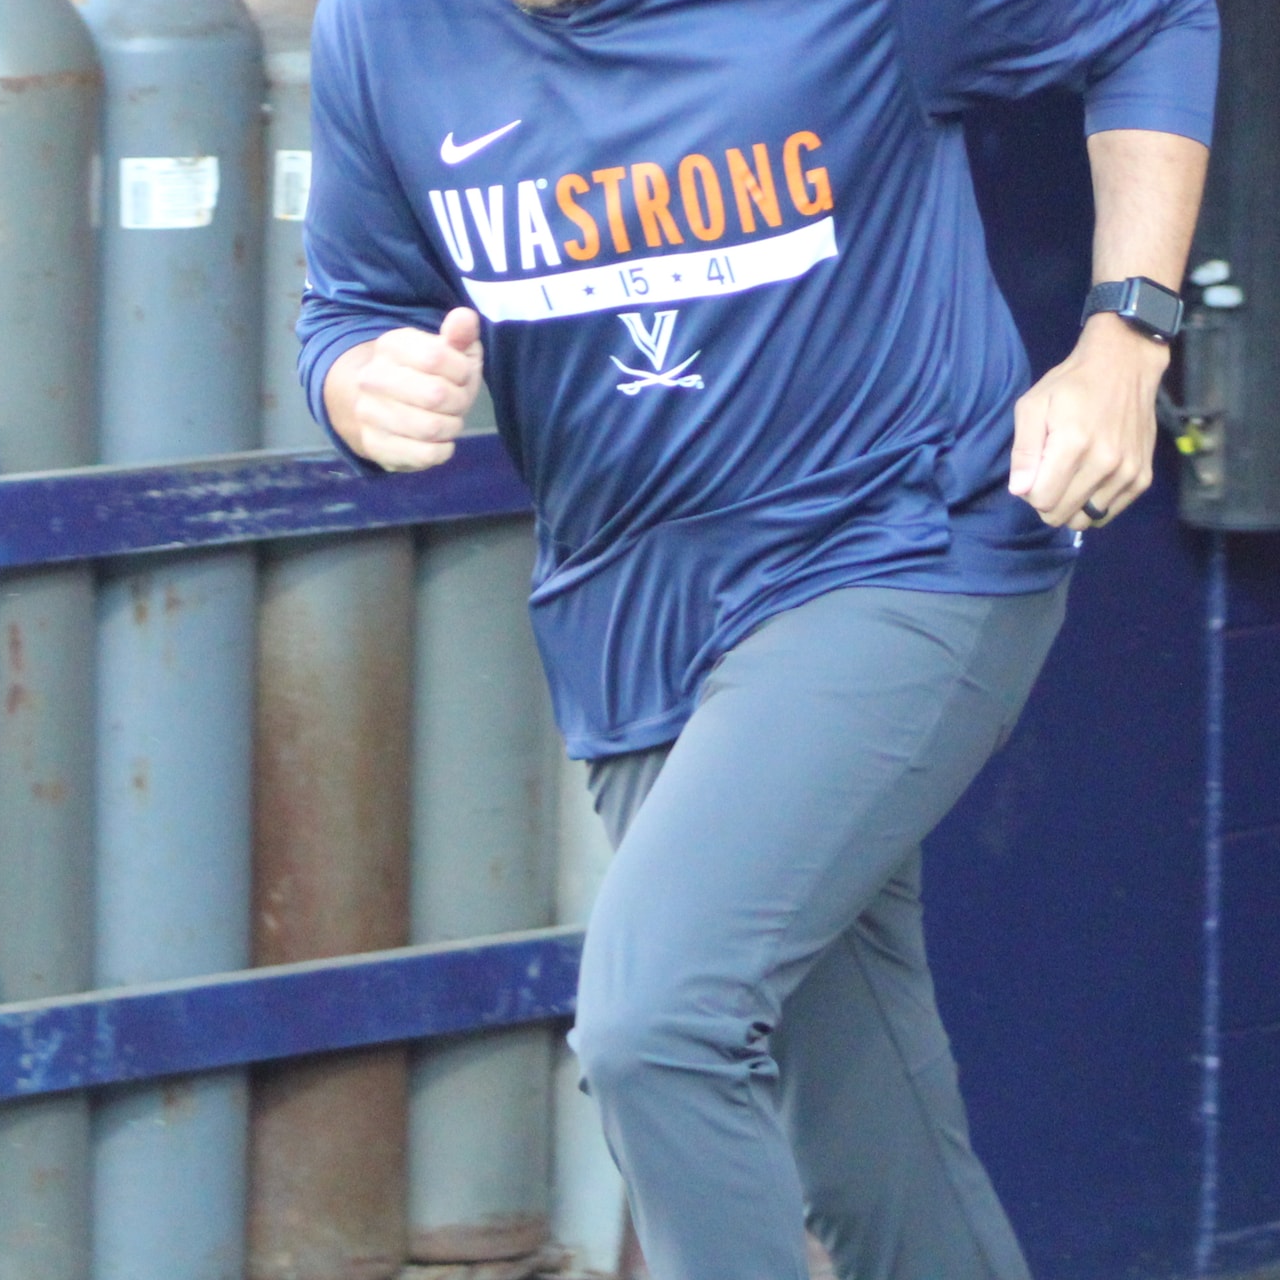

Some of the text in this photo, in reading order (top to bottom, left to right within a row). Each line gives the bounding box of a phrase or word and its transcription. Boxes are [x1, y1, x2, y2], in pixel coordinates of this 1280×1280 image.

[540, 255, 735, 312] 1 15 41
